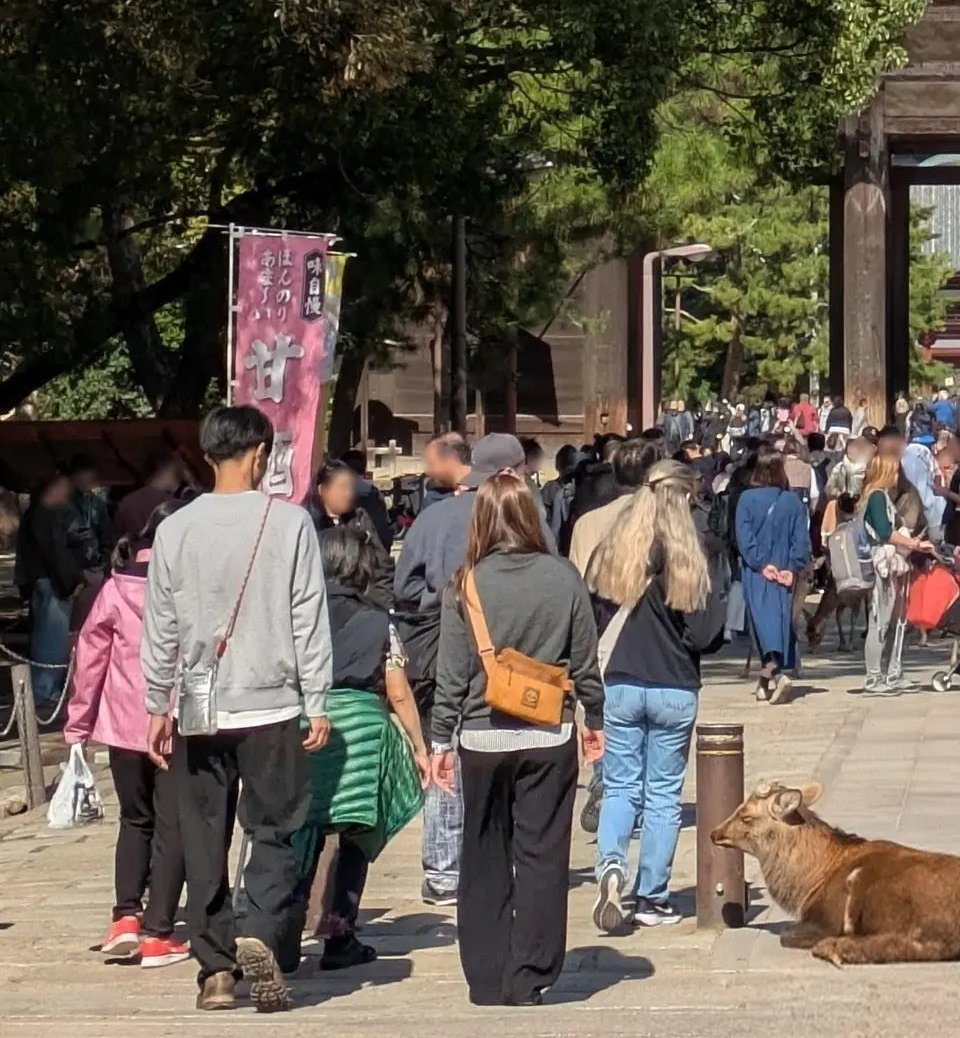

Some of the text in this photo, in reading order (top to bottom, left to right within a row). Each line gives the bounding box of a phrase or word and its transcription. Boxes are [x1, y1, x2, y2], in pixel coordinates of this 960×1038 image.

[276, 249, 293, 322] ほんのり
[304, 257, 322, 316] 味自慢
